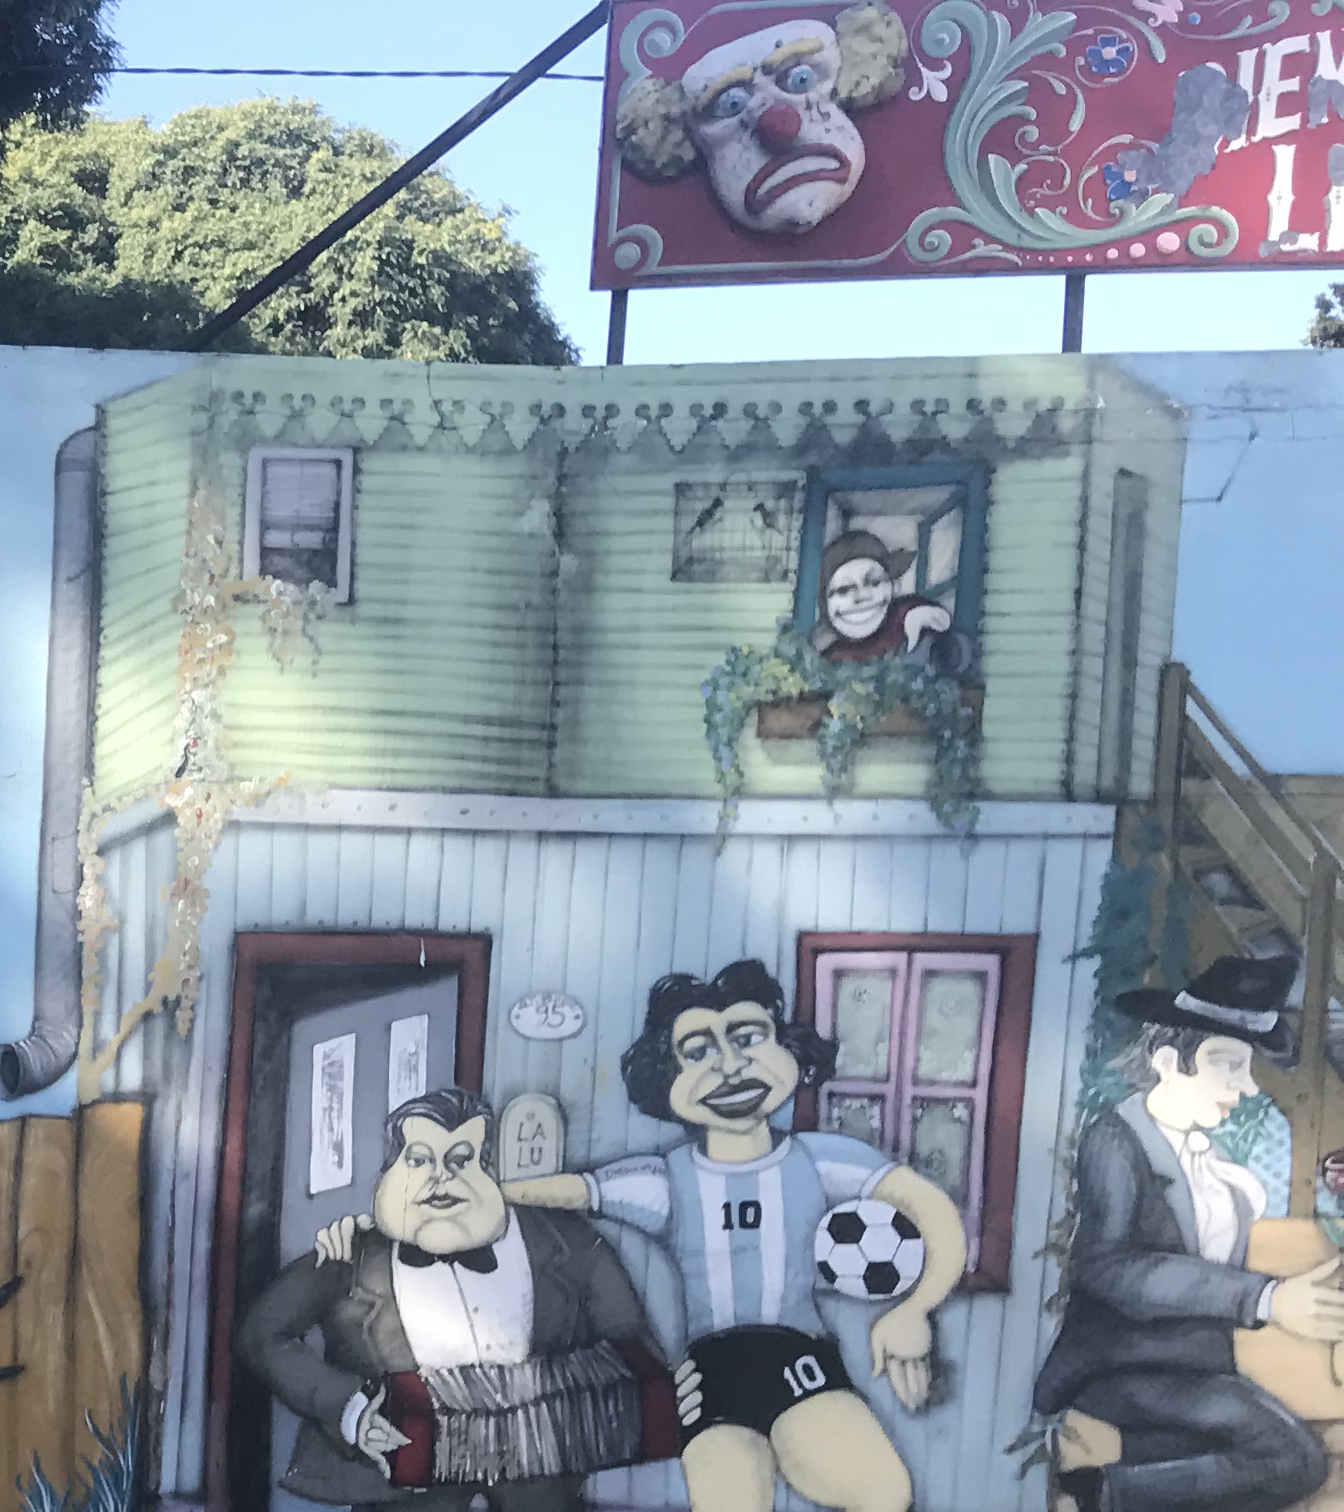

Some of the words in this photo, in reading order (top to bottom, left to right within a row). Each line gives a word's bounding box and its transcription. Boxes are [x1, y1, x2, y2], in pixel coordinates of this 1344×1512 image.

[517, 1121, 547, 1143] LA
[517, 1146, 544, 1170] LU
[721, 1200, 762, 1231] 10
[783, 1354, 827, 1398] 10
